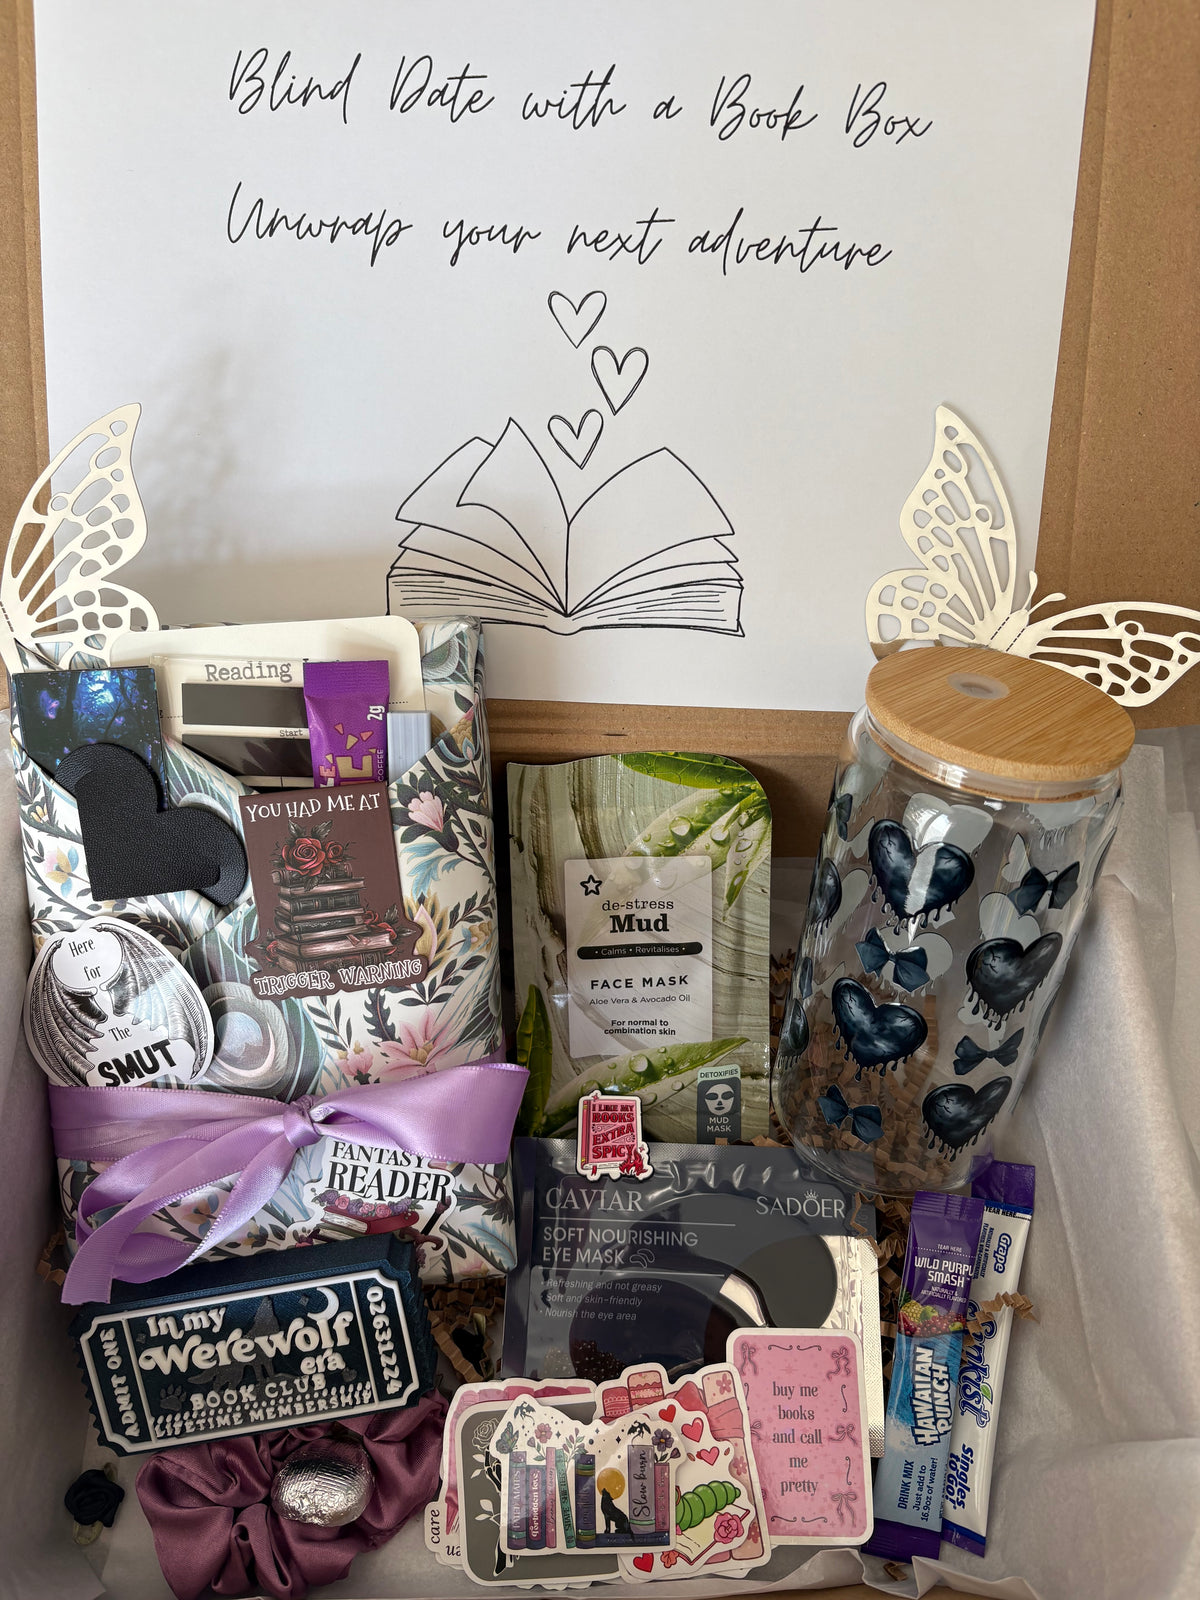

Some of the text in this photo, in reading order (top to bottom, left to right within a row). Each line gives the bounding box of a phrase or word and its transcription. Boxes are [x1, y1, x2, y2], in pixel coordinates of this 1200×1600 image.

[229, 47, 932, 147] Blind Date with a Book Box
[227, 182, 893, 276] Unwrap your next adventure
[205, 661, 293, 683] Reading
[367, 705, 385, 721] 2g
[279, 729, 303, 738] Start
[246, 793, 380, 822] YOU HAD ME AT
[602, 898, 674, 911] de-stress
[609, 913, 670, 933] Mud
[68, 938, 95, 958] Here
[601, 945, 680, 956] Calms Revitalises
[84, 966, 101, 981] for
[254, 959, 422, 996] TRIGGER WARNING
[590, 975, 689, 990] FACE MASK
[589, 998, 609, 1006] Aloe
[611, 997, 630, 1005] Vera
[640, 995, 677, 1004] Avocado
[679, 994, 691, 1002] Oil
[604, 1027, 676, 1036] combination skin
[611, 1018, 669, 1027] For normal to
[109, 1027, 132, 1041] The
[97, 1039, 177, 1087] SMUT
[700, 1068, 739, 1078] DETOXIFIES
[592, 1104, 597, 1112] I
[620, 1104, 634, 1112] MY
[592, 1112, 635, 1123] BOOKS
[592, 1123, 635, 1146] EXTRA
[331, 1141, 425, 1168] FANTASY
[592, 1144, 635, 1160] SPICY
[325, 1161, 451, 1206] READER
[545, 1187, 645, 1213] CAVIAR
[543, 1226, 699, 1247] SOFT NOURISHING
[542, 1247, 625, 1265] EYE MASK
[993, 1233, 1012, 1273] Grape
[914, 1256, 974, 1277] WILD PURPL
[546, 1279, 663, 1293] Refreshing and not greasy
[928, 1271, 965, 1288] SMASH
[547, 1293, 643, 1307] Soft and skin-friendly
[147, 1307, 226, 1340] In my
[545, 1308, 637, 1321] Nourish the eye area
[138, 1310, 354, 1375] Werewolf
[366, 1285, 403, 1394] 02631224
[300, 1349, 346, 1375] era
[100, 1328, 140, 1437] ADMIT ONE
[190, 1373, 326, 1411] BOOK CLUB
[772, 1381, 819, 1400] buy me
[911, 1344, 941, 1447] HAWAIIAN
[931, 1361, 952, 1436] PUNCH
[155, 1389, 372, 1438] LIFETIME MEMBERSHIP
[778, 1405, 815, 1421] books
[772, 1428, 823, 1444] and call
[789, 1456, 809, 1469] me
[929, 1457, 938, 1484] water!
[632, 1450, 651, 1517] Slow burn
[897, 1460, 914, 1509] DRINK MIX
[945, 1453, 960, 1503] to Go!
[956, 1443, 974, 1509] Singles
[780, 1479, 819, 1497] pretty
[913, 1465, 926, 1511] Just add to
[927, 1485, 933, 1494] of
[431, 1509, 440, 1544] care
